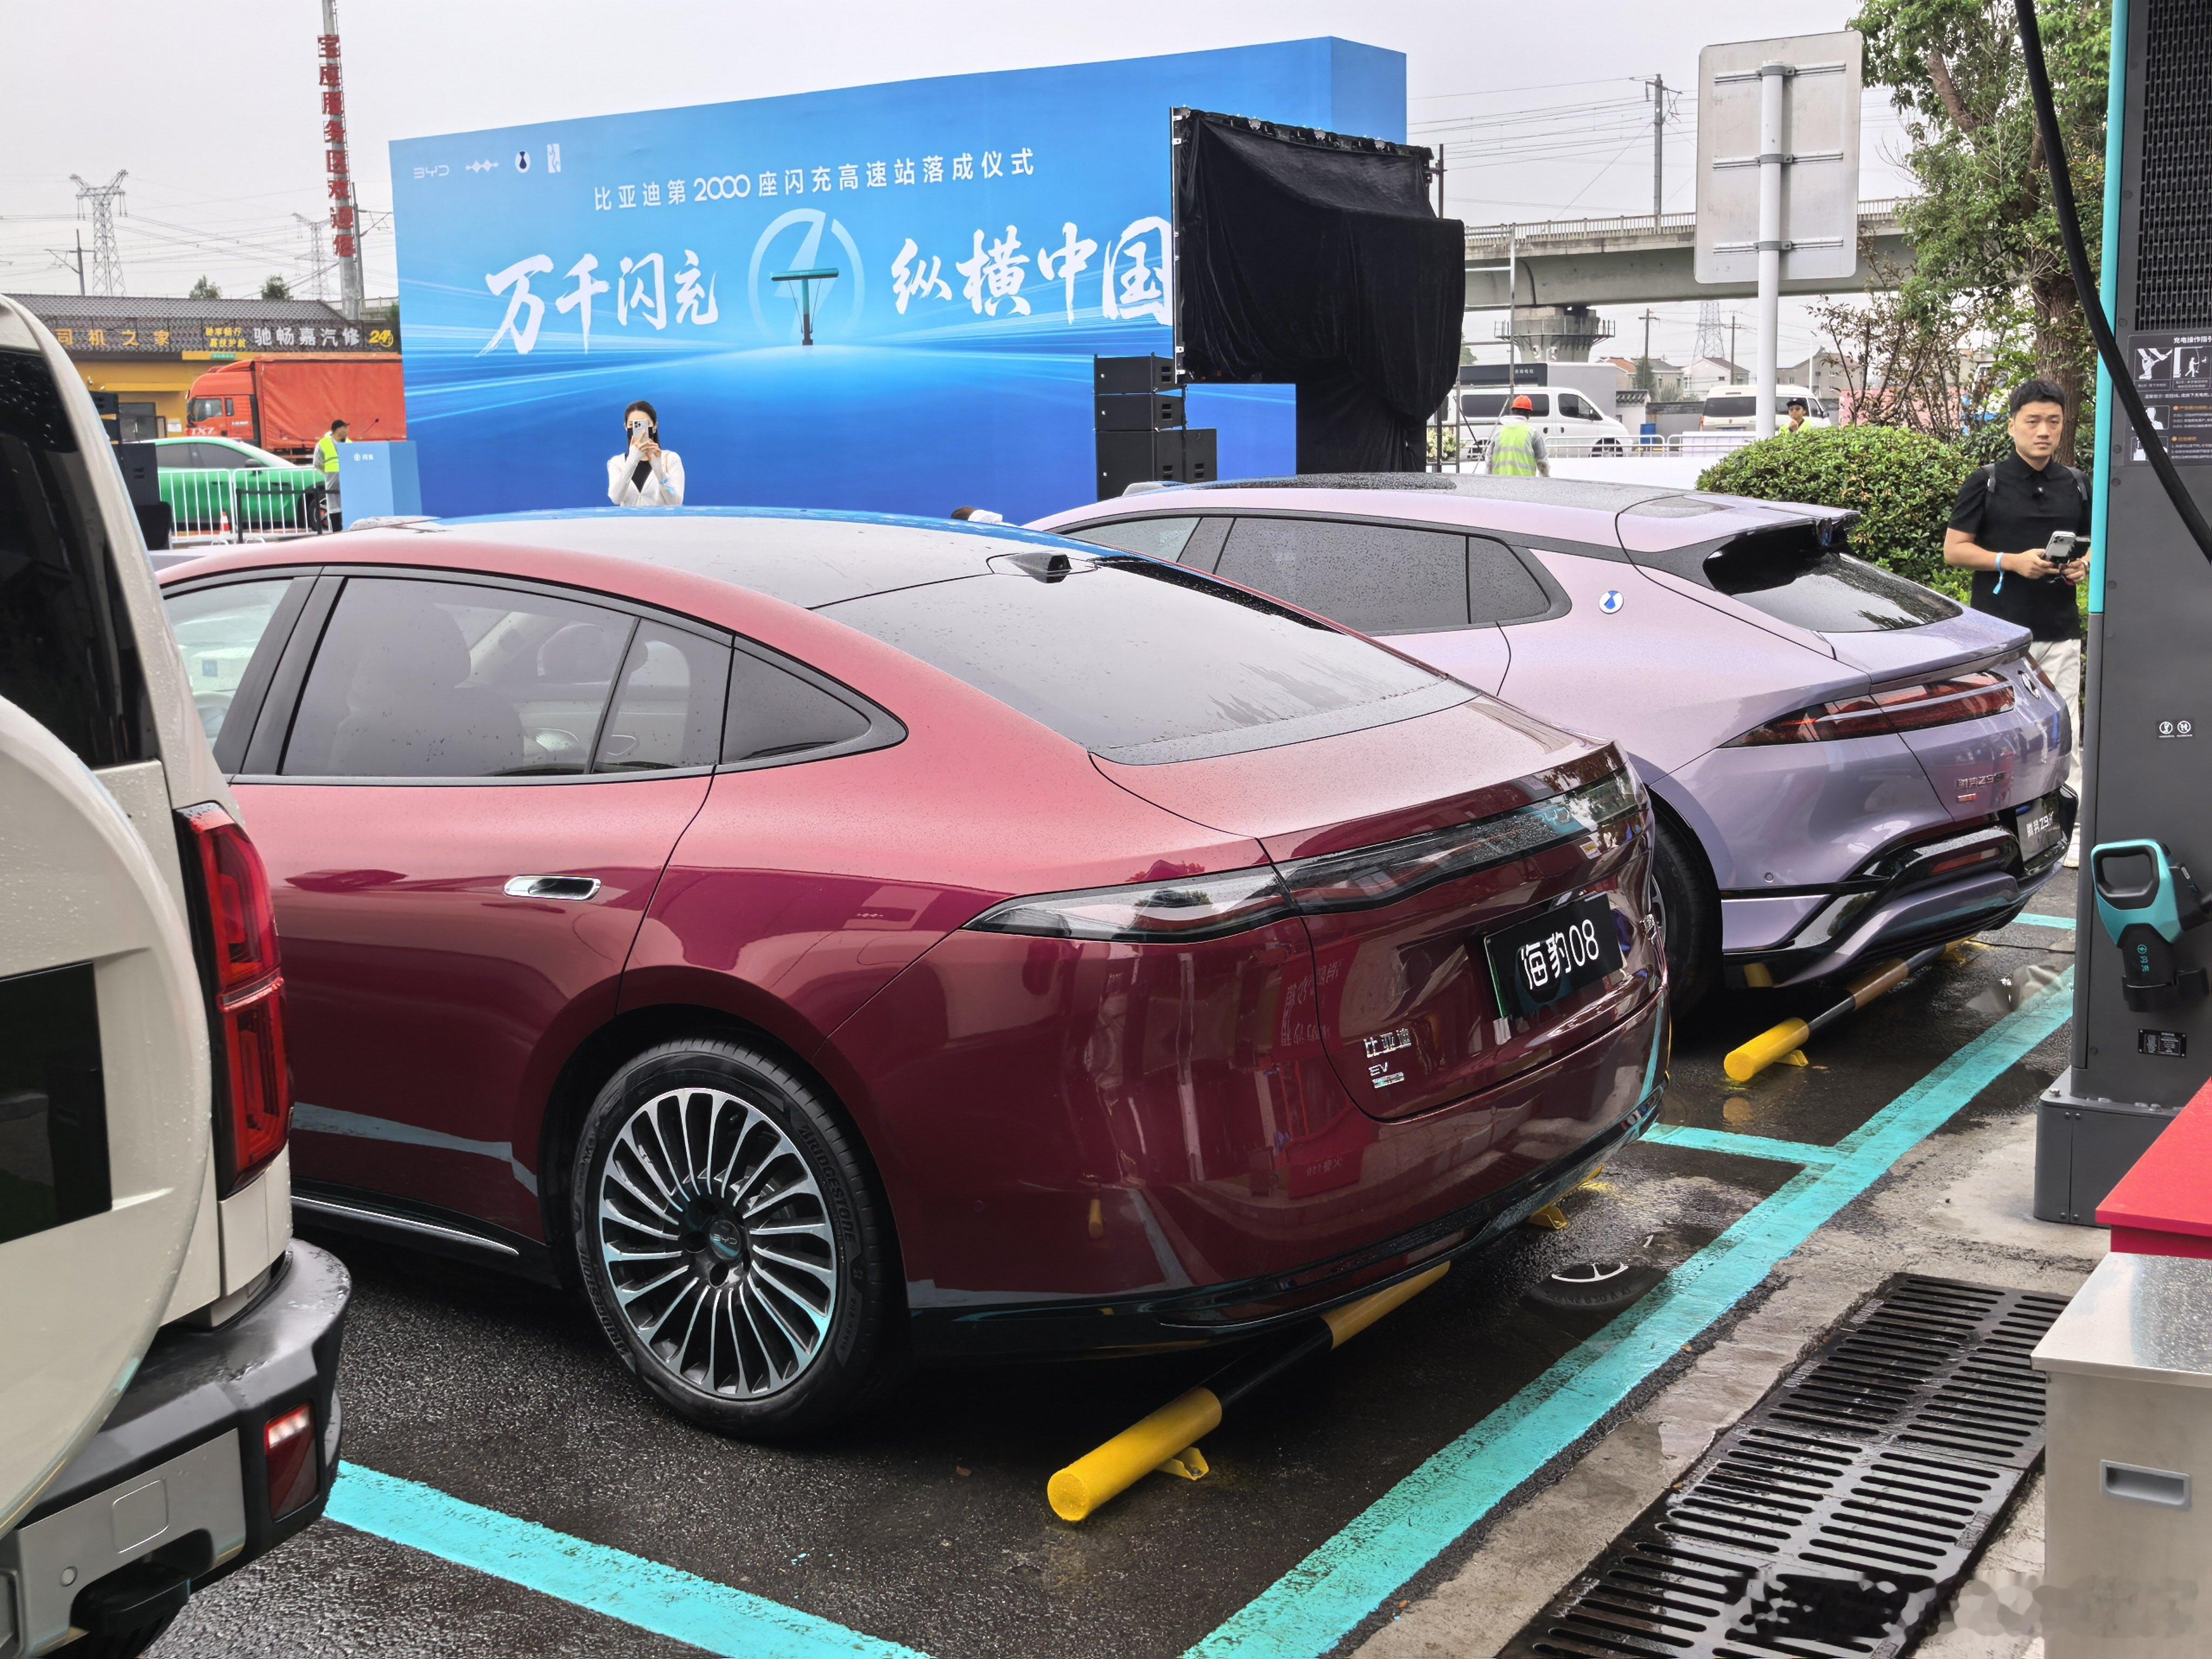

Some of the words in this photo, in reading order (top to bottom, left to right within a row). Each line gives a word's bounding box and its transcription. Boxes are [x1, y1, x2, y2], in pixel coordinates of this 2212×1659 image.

[318, 35, 356, 258] 宝应服务区欢迎您
[414, 164, 449, 179] BYD
[475, 249, 719, 357] 万千闪充
[892, 216, 1173, 326] 纵横中国
[55, 328, 170, 346] 司机之家
[253, 327, 360, 347] 驰畅嘉汽修
[1521, 919, 1599, 990] 海豹08
[1363, 1028, 1412, 1058] 比亚迪
[1368, 1061, 1388, 1076] EV
[798, 1124, 857, 1243] BRIDGESTONE
[713, 1233, 738, 1245] BYD
